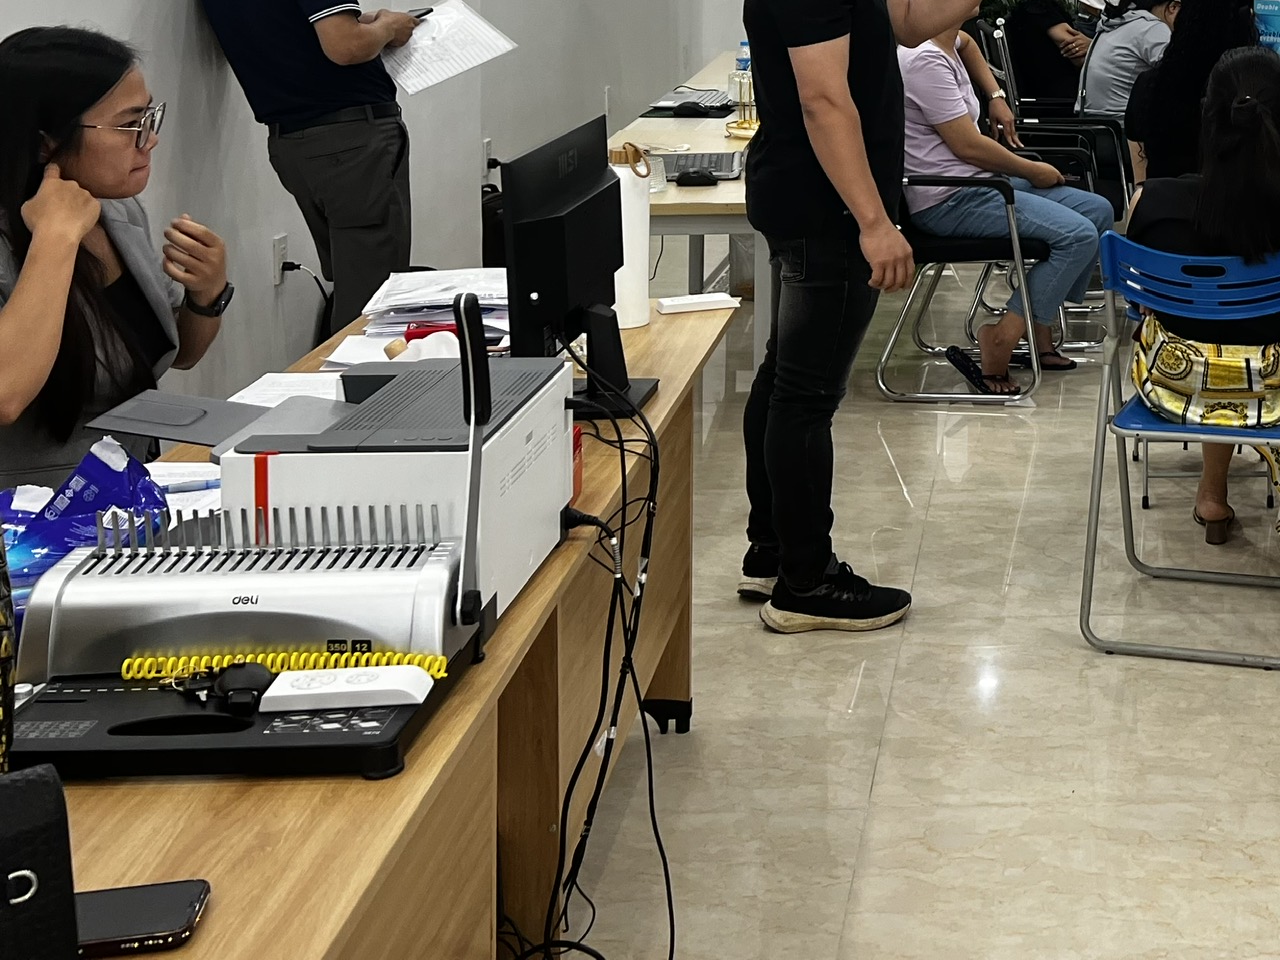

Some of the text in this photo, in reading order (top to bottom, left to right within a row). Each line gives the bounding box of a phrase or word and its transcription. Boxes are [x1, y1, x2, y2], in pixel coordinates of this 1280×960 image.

[1256, 3, 1279, 11] Double
[231, 595, 259, 605] deli
[327, 643, 369, 652] 350 12
